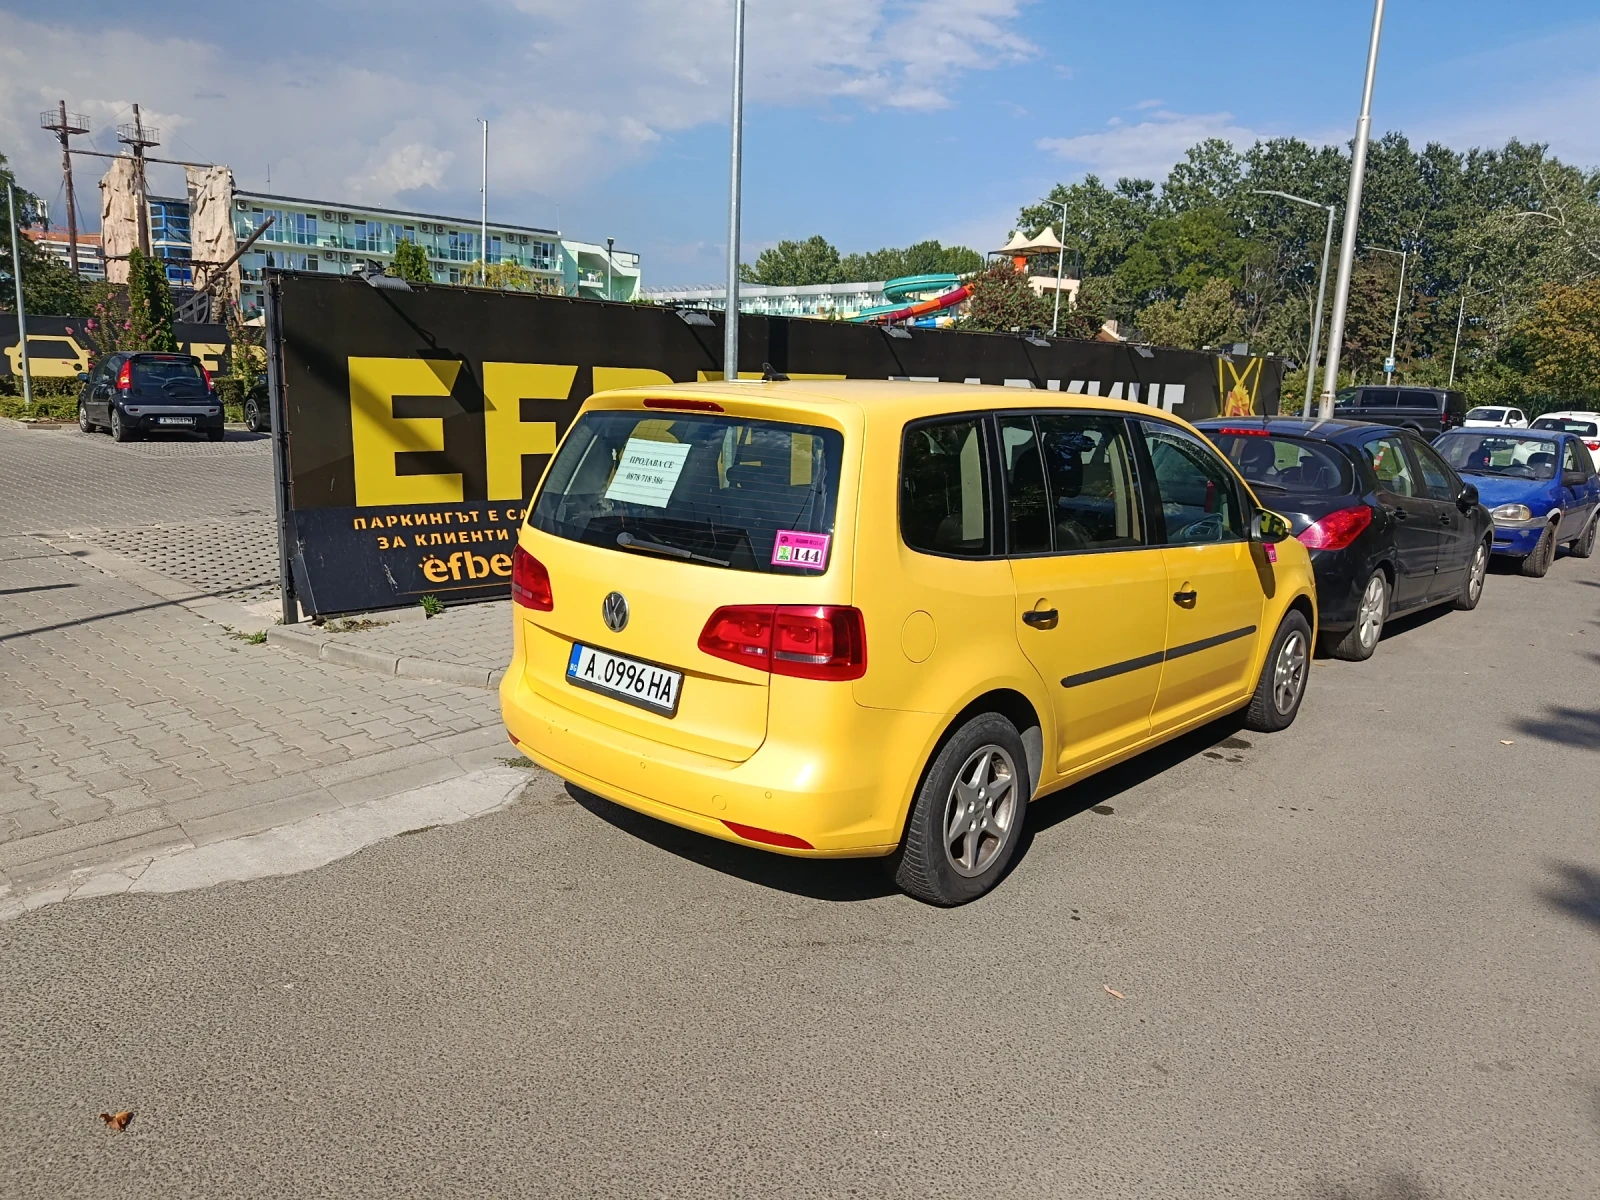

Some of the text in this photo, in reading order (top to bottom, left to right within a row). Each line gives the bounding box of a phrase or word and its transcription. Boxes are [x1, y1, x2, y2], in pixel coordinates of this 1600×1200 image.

[629, 456, 675, 469] ПРОДАВА СЕ
[626, 472, 664, 485] 0878 718 386
[354, 511, 479, 529] ПАРКИНГЪТ
[488, 509, 499, 522] Е
[377, 535, 407, 550] ЗА
[414, 528, 509, 547] КЛИЕНТИ
[793, 548, 820, 563] 144
[421, 551, 514, 583] efbe
